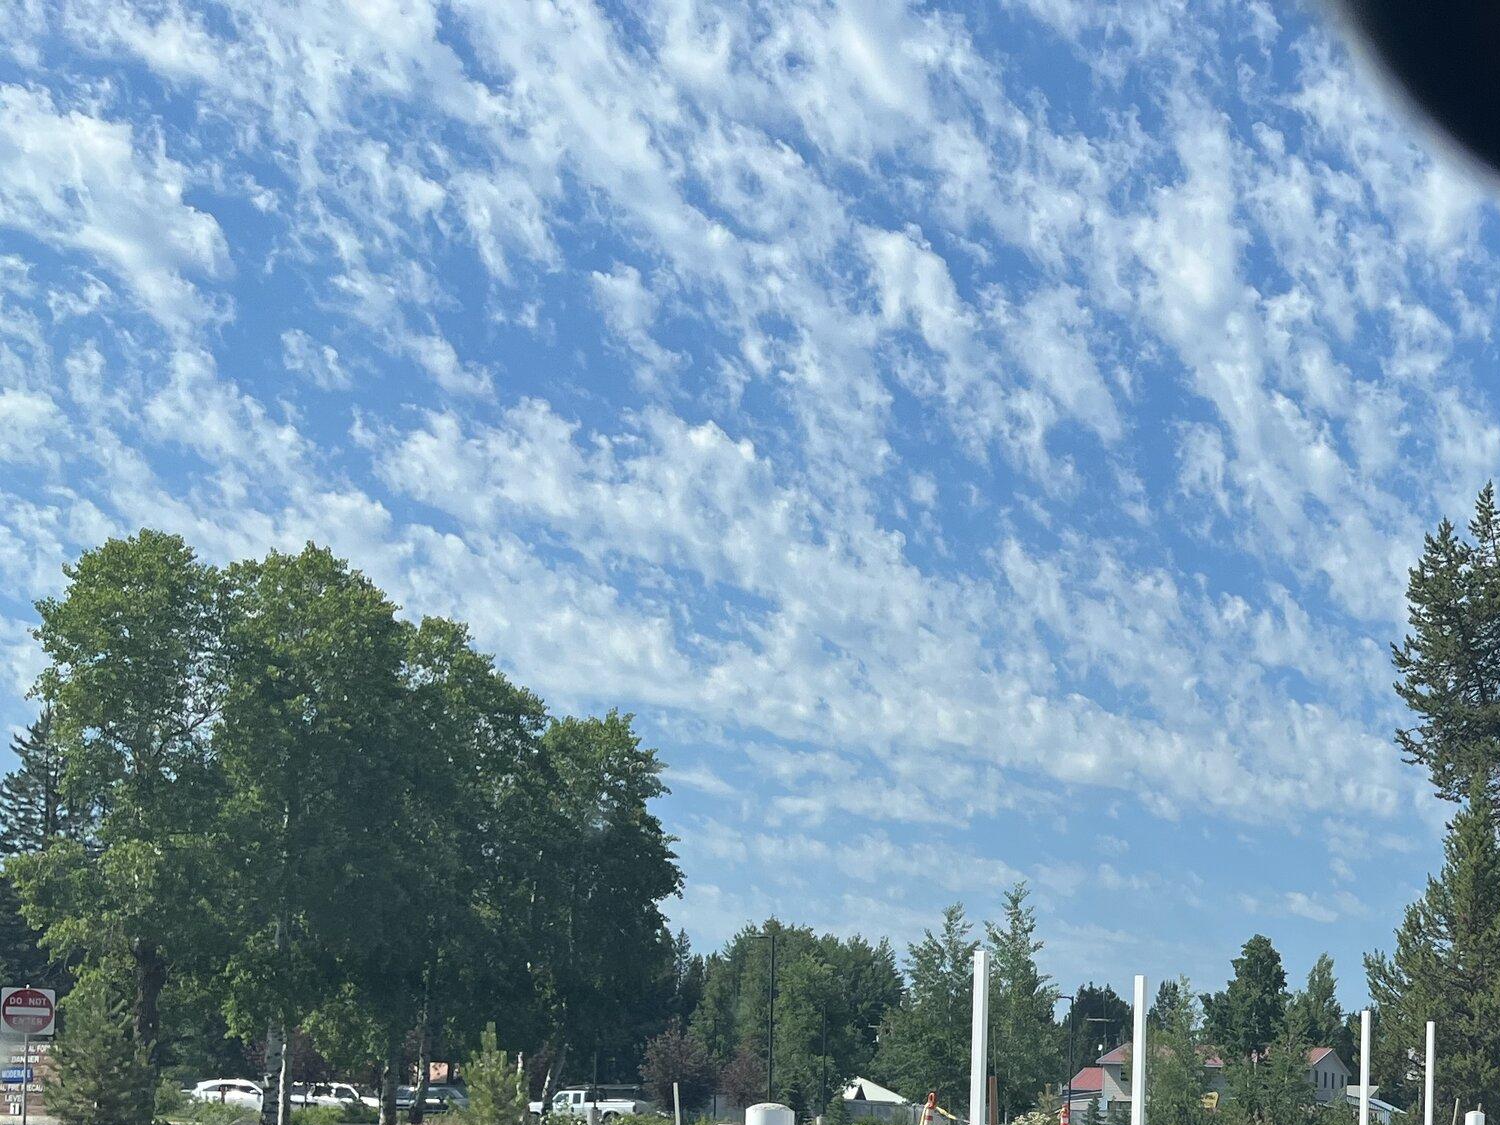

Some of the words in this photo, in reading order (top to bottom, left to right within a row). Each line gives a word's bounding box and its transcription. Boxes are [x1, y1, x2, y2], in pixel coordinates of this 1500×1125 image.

[10, 997, 23, 1005] DO
[29, 998, 47, 1006] NOT
[13, 1017, 43, 1025] ENTER
[2, 1069, 31, 1078] MODERAE
